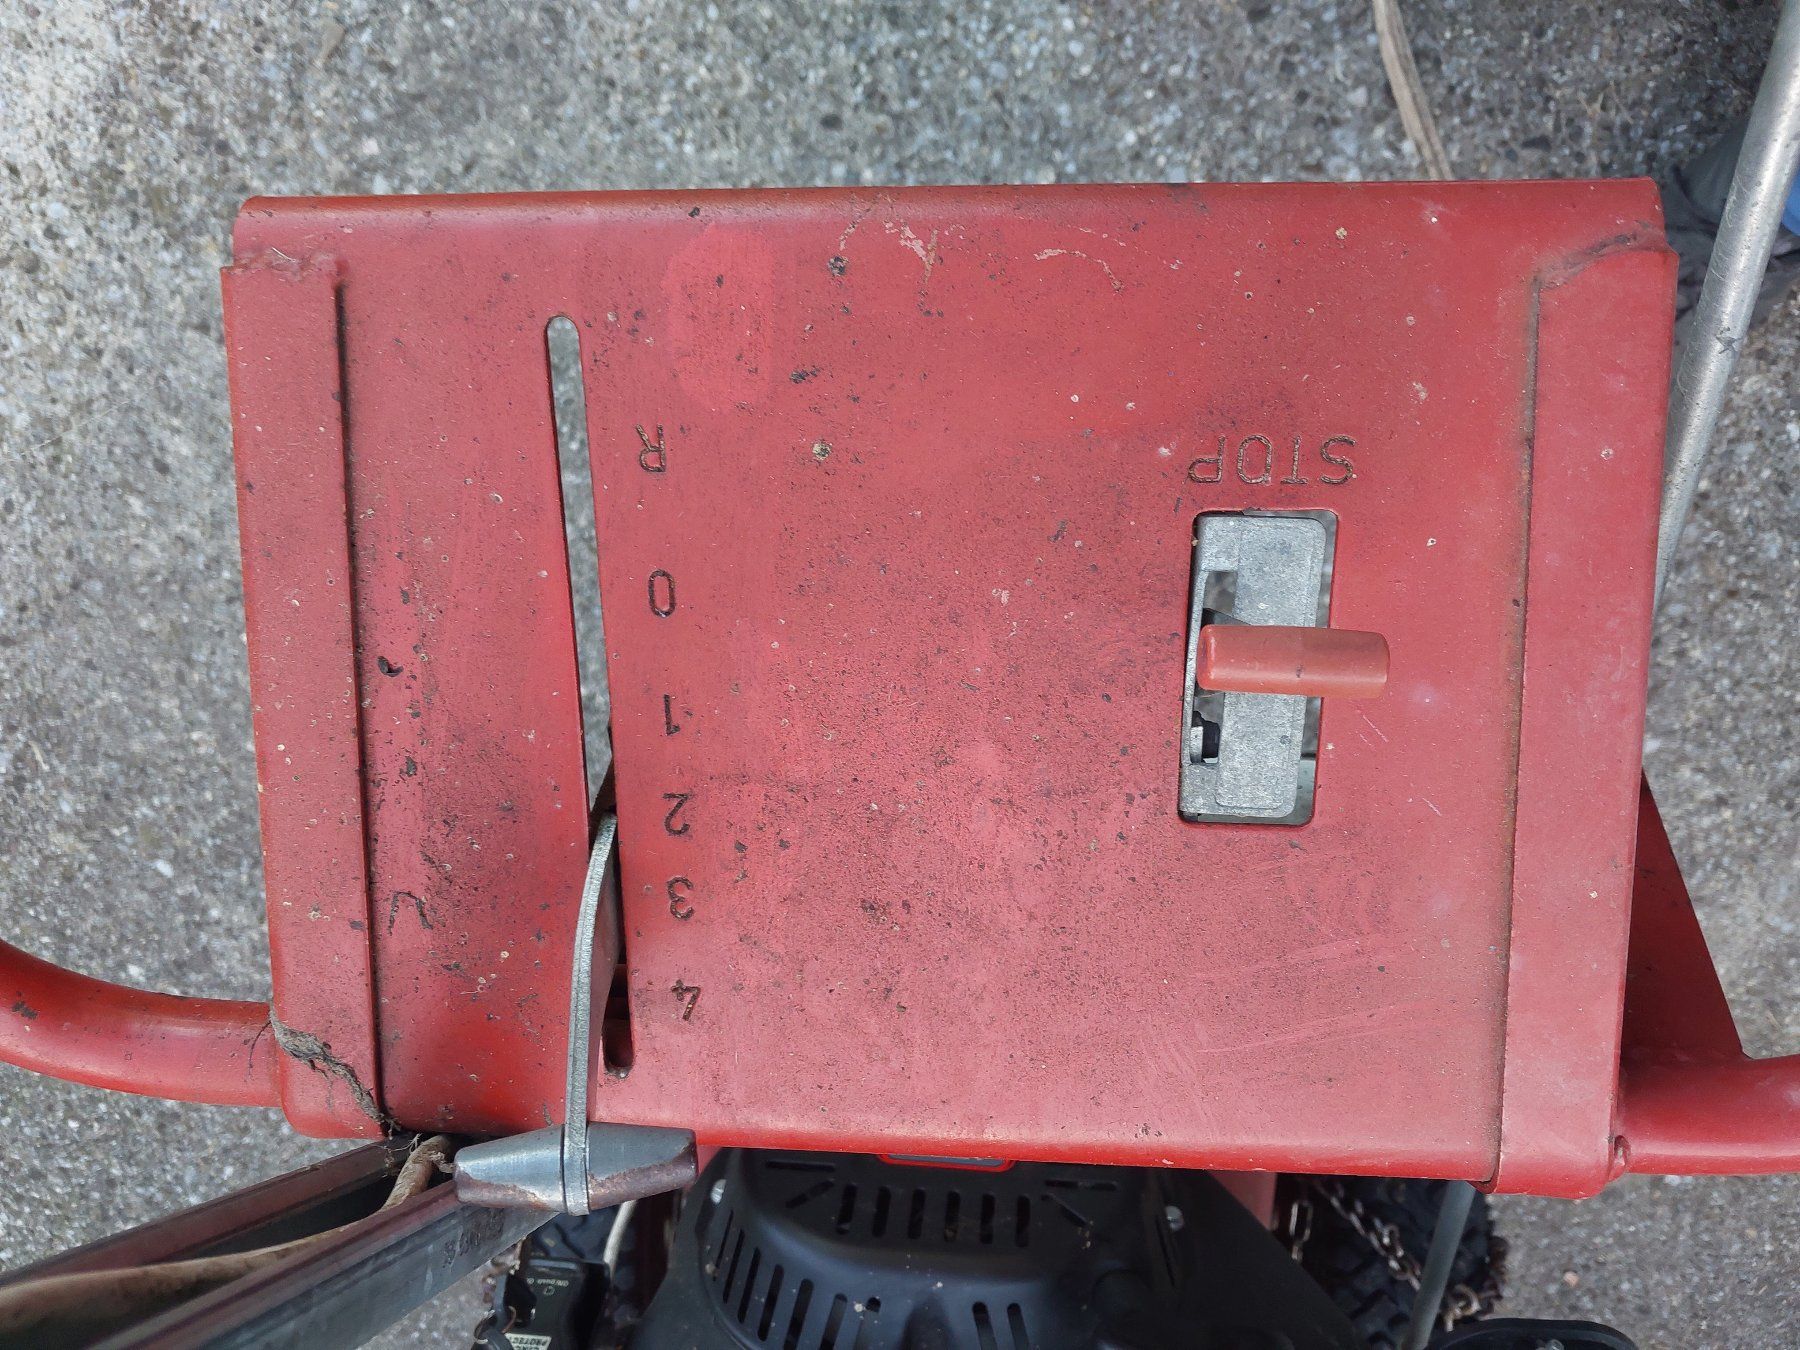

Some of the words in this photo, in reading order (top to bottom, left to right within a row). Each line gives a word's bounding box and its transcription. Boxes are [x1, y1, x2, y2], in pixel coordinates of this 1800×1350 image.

[636, 424, 666, 472] R
[1188, 434, 1356, 484] STOP
[663, 694, 680, 736] 1
[663, 793, 693, 835] 2
[667, 876, 694, 920] 3
[671, 979, 701, 1021] 4
